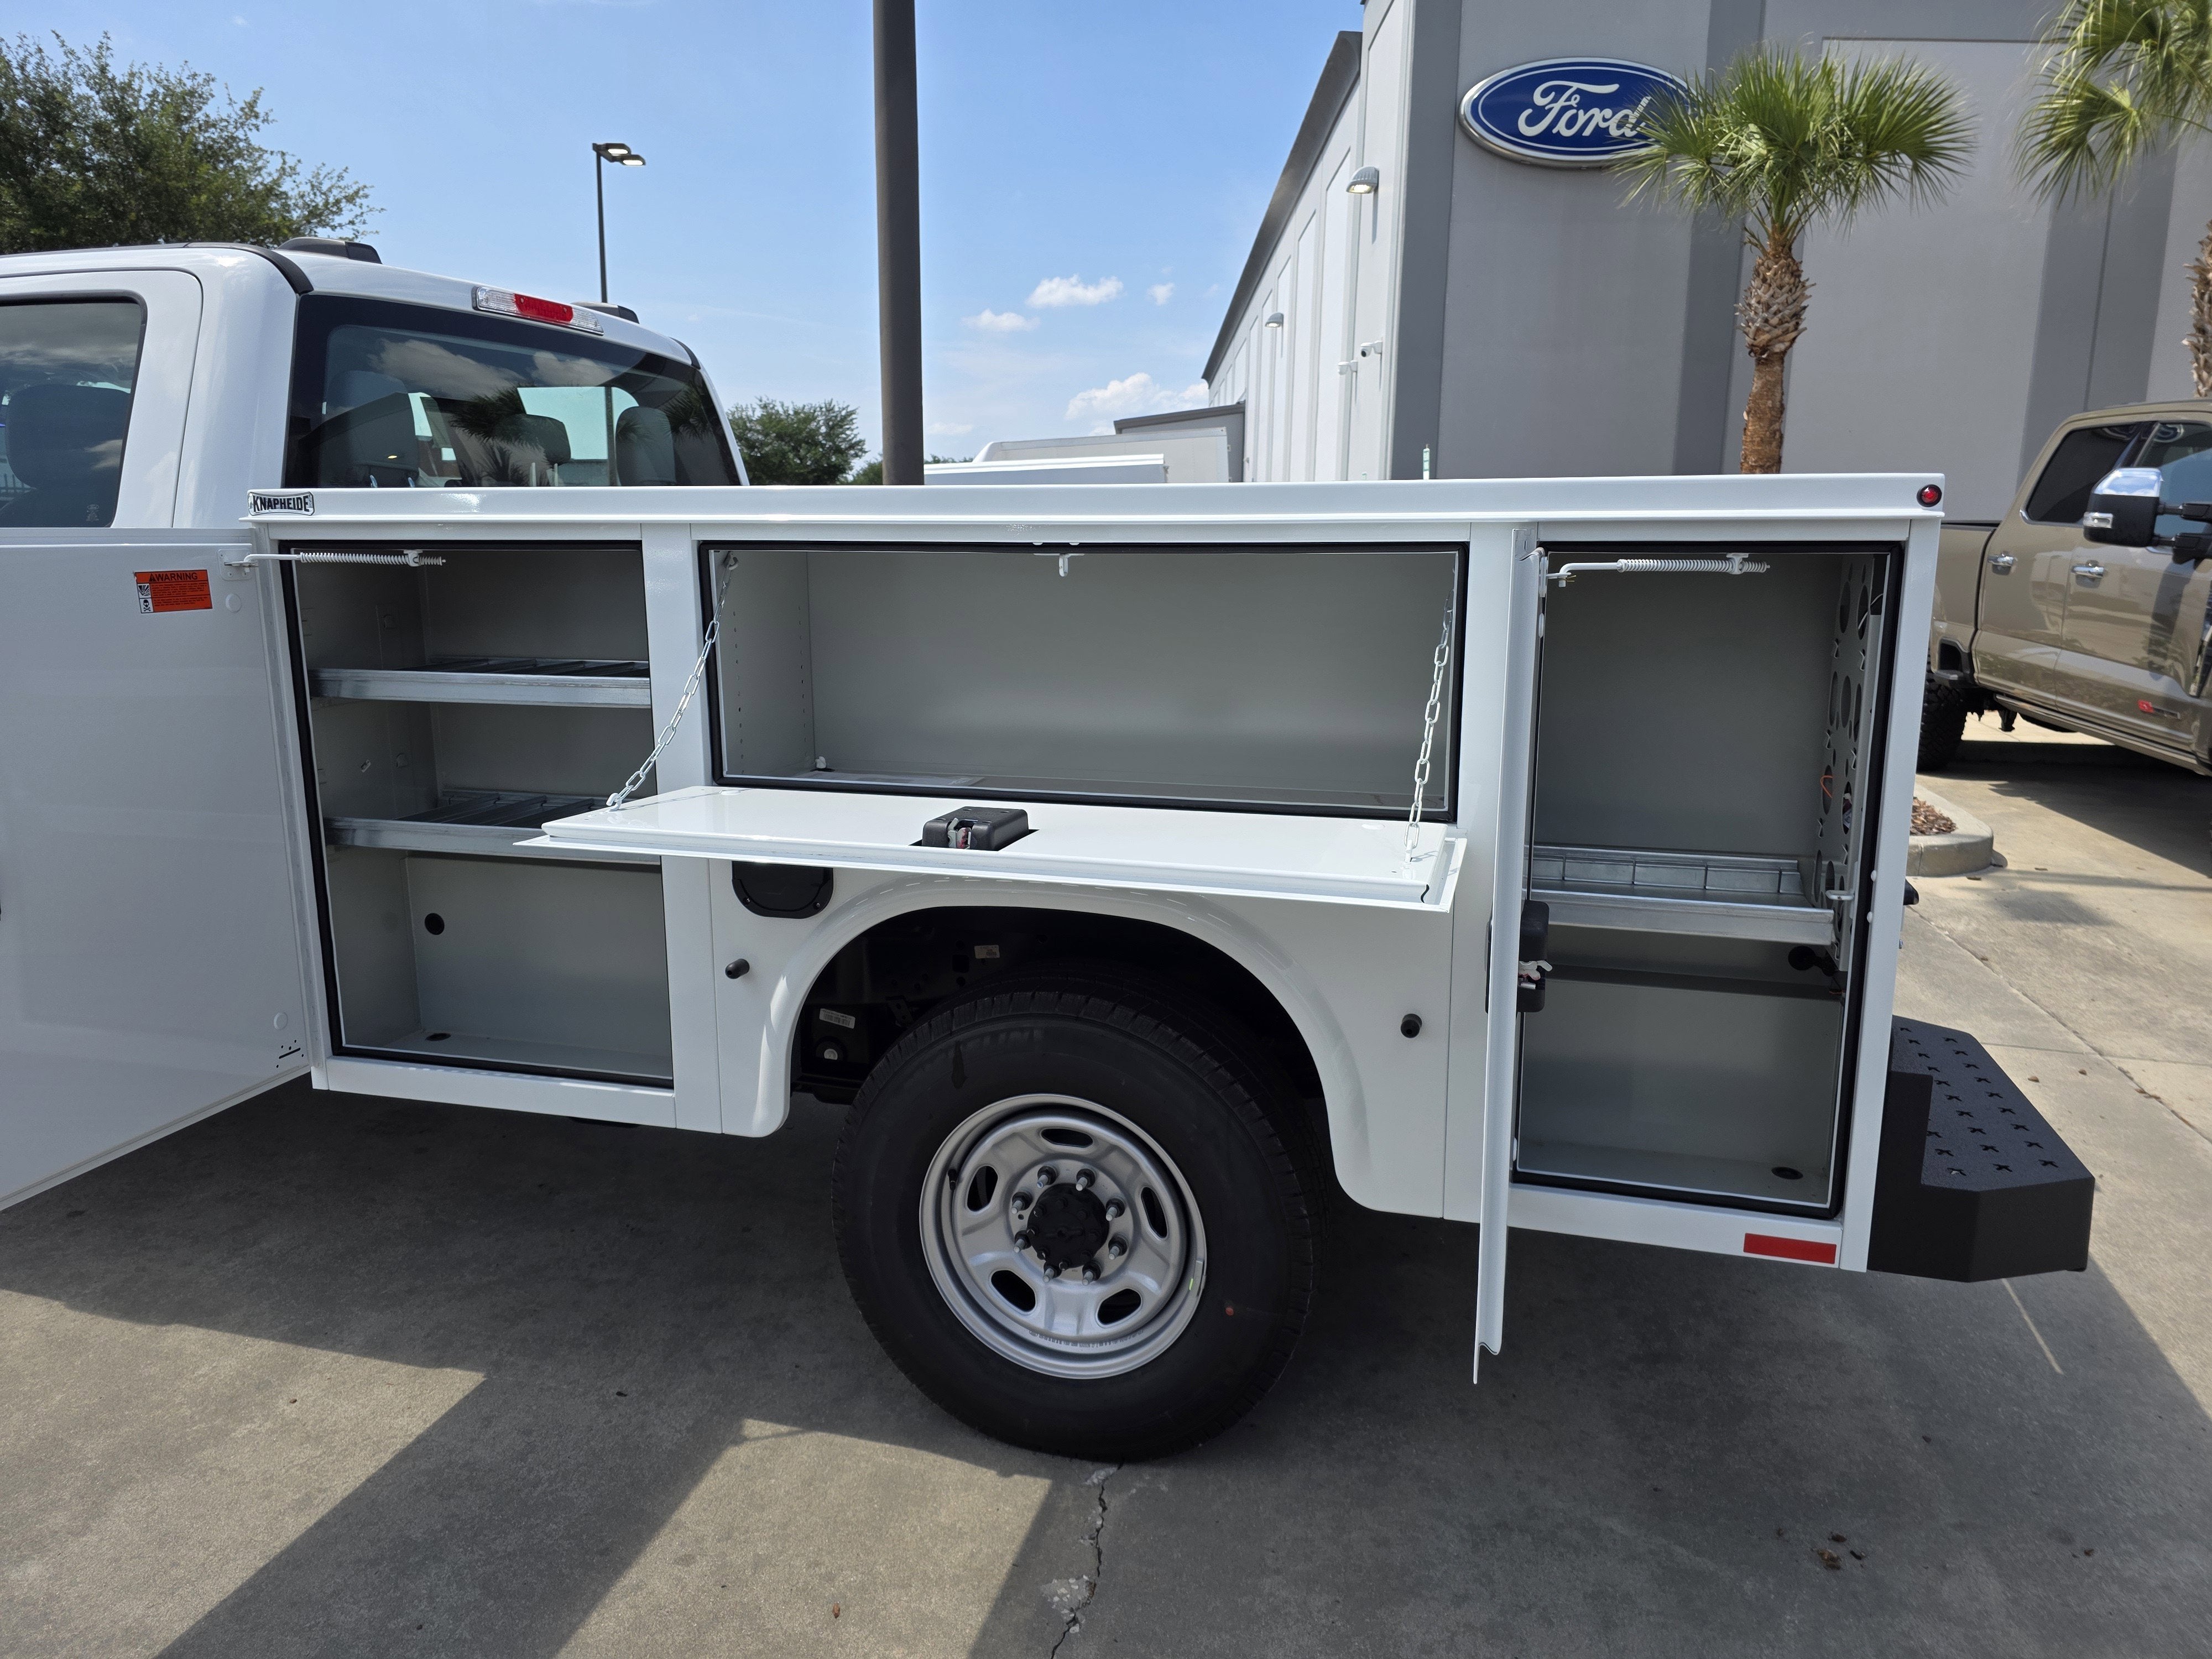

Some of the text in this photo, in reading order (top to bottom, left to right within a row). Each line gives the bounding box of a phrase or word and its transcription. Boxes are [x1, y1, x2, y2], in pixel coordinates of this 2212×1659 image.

[1517, 80, 1652, 137] Ford
[252, 495, 310, 512] KNAPHEIDE
[155, 572, 198, 582] WARNING
